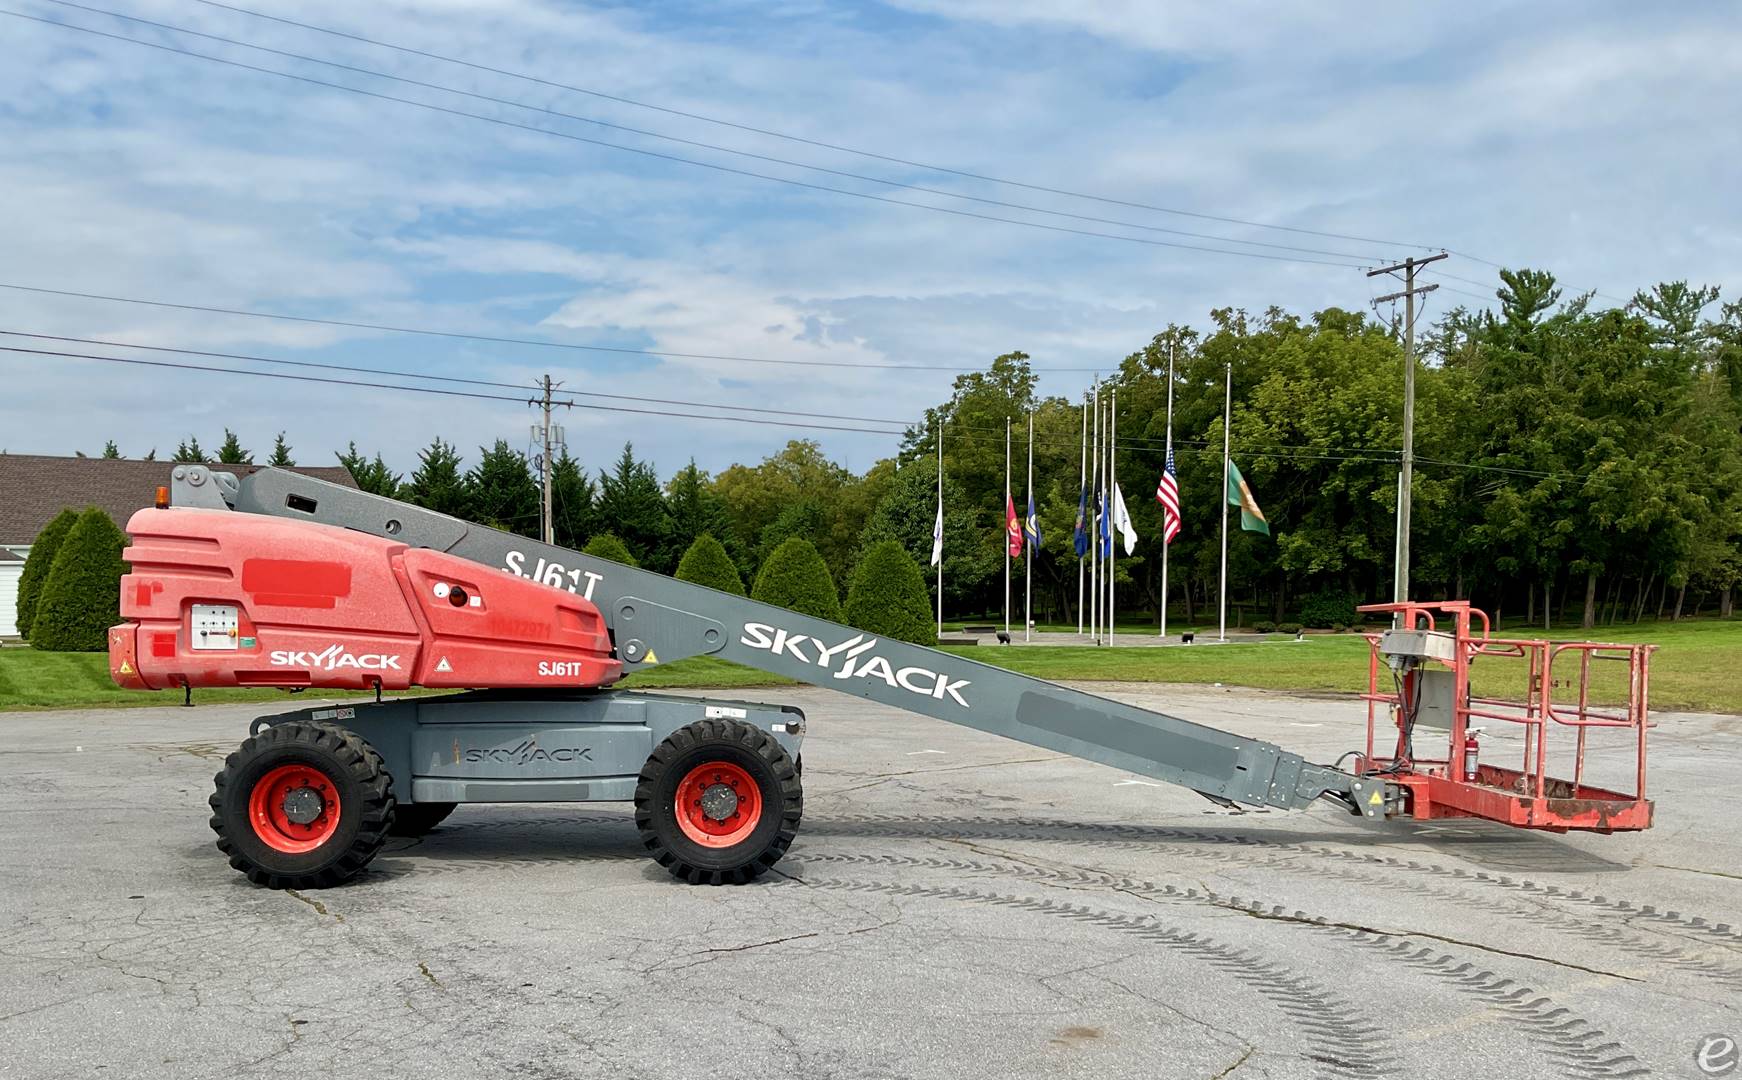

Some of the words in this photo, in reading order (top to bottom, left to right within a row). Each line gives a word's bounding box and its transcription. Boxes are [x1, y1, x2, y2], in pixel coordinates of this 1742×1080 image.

[501, 550, 604, 602] SJ61T
[270, 643, 402, 671] SKYJACK
[538, 661, 582, 676] SJ61T
[740, 622, 972, 708] SKYJACK
[465, 740, 593, 766] SKYJACK
